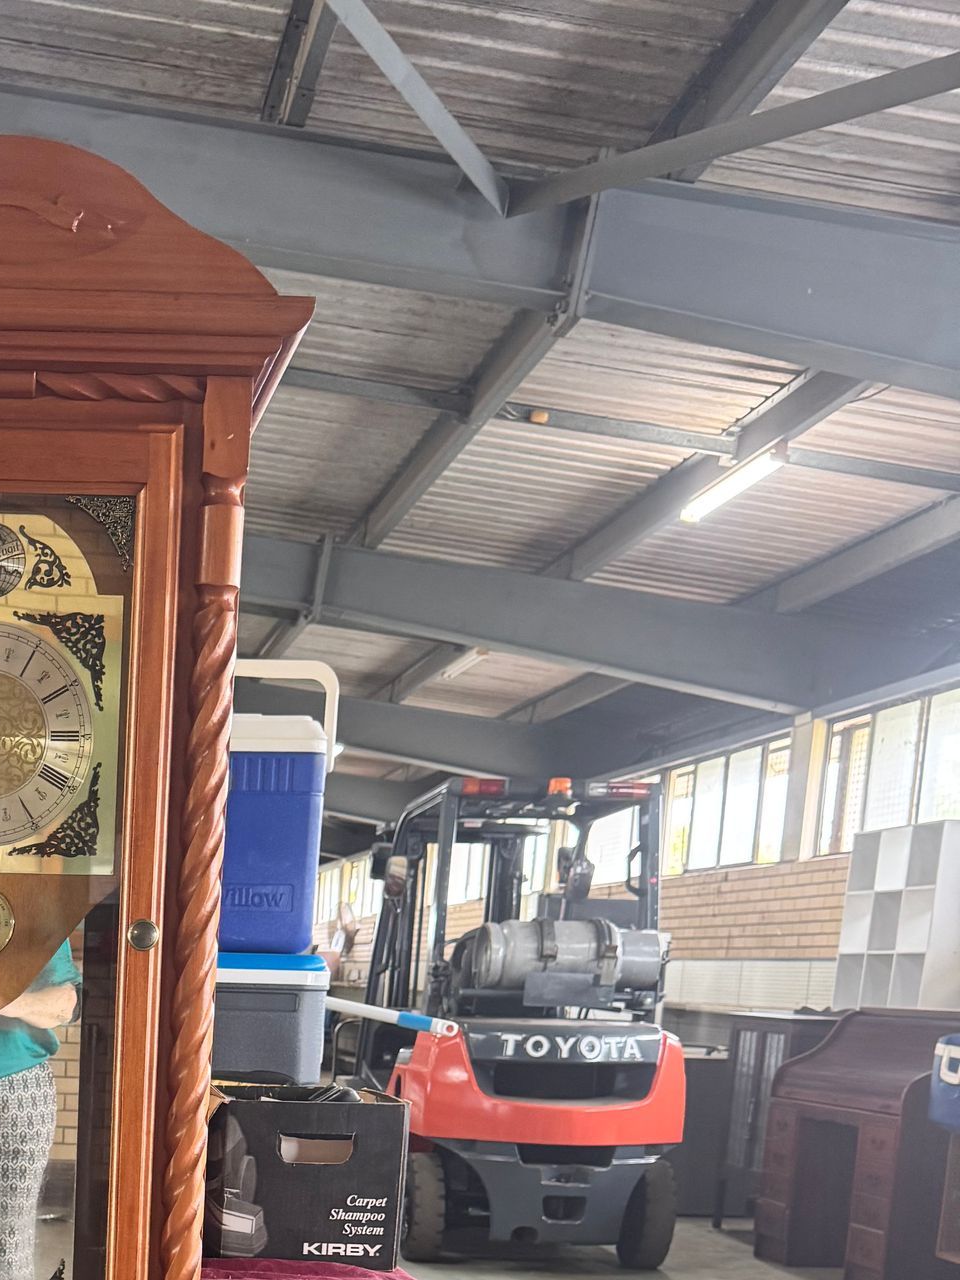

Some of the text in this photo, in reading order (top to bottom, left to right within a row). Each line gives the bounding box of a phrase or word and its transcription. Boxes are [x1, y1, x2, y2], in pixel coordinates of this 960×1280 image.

[41, 684, 70, 705] II
[50, 730, 80, 742] III
[501, 1034, 642, 1060] TOYOTA
[346, 1194, 388, 1209] Carpet
[329, 1208, 386, 1223] Shampoo
[342, 1222, 384, 1237] System
